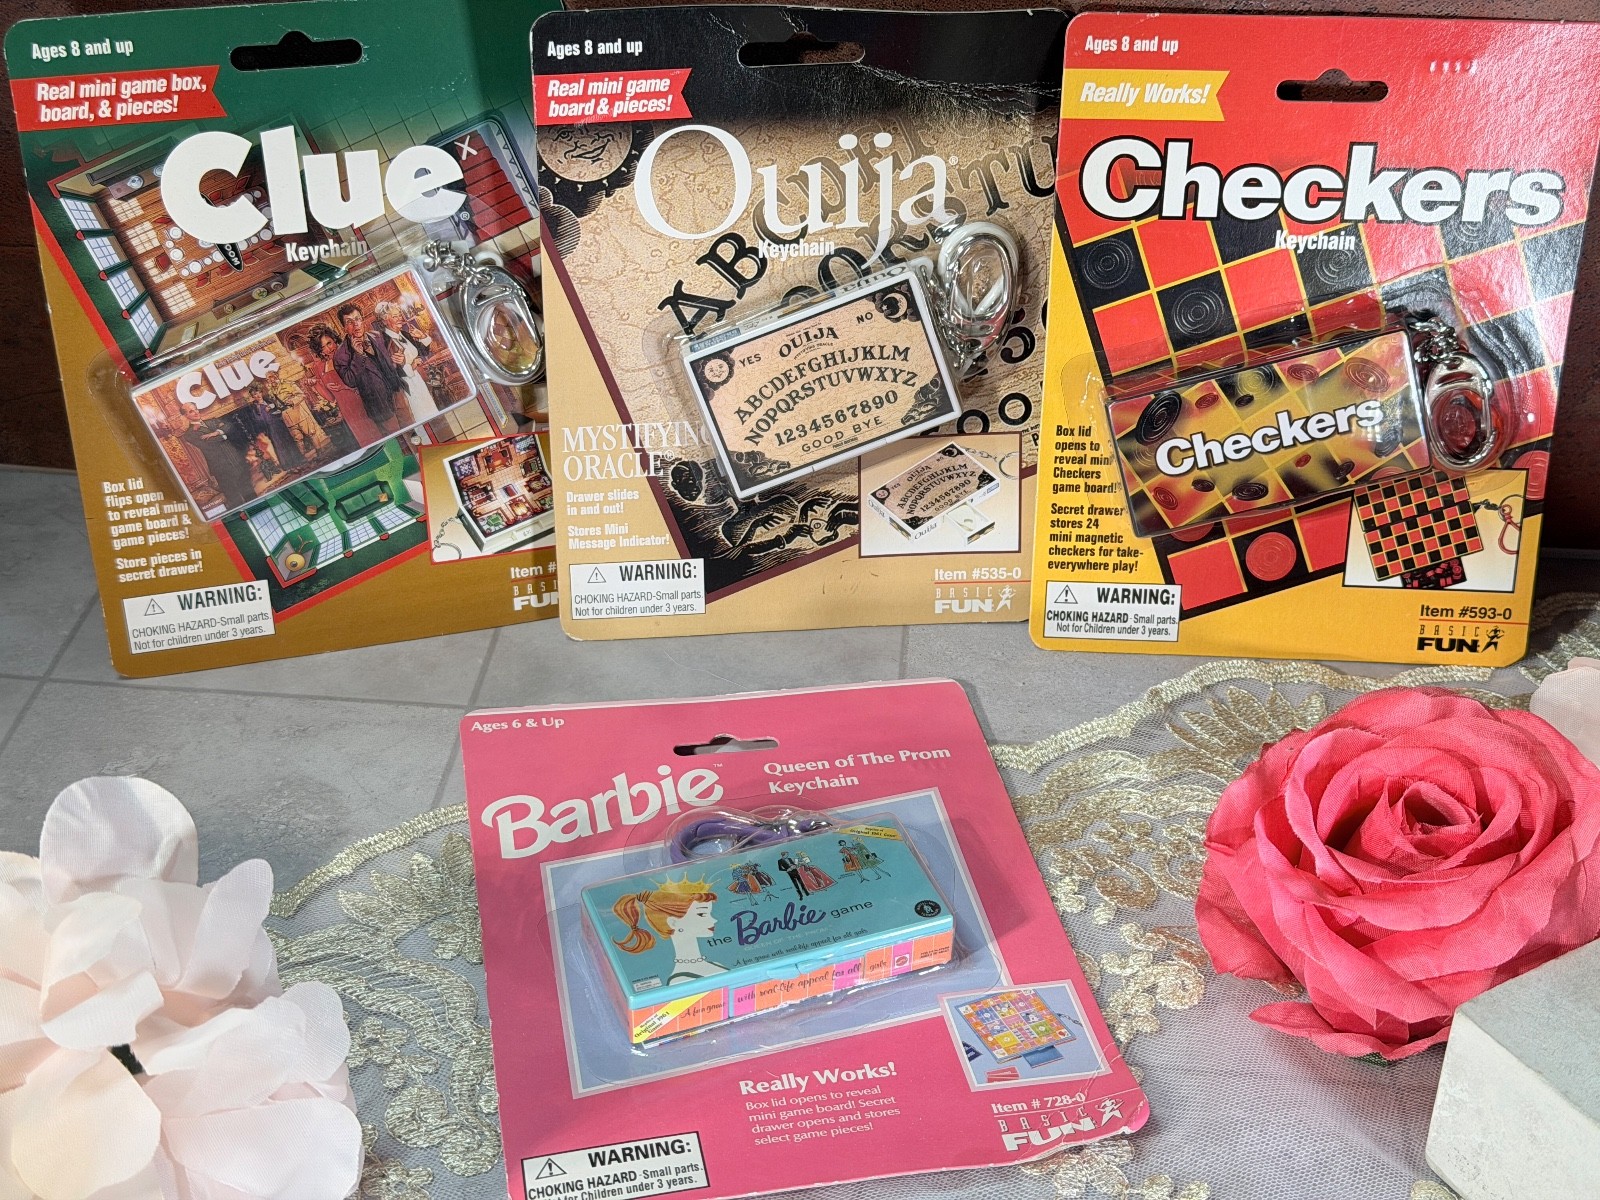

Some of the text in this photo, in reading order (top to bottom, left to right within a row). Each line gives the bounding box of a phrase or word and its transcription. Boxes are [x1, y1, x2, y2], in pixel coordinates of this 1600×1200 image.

[32, 38, 134, 62] Ages 8 and up
[547, 38, 643, 59] Ages 8 and up
[1084, 35, 1179, 55] Ages 8 and up
[37, 74, 207, 101] Real mini game box,
[547, 76, 671, 97] Real mini game
[1081, 82, 1212, 107] Really Works!
[40, 96, 178, 122] board, & pieces!
[548, 95, 673, 118] board & pieces!
[160, 125, 467, 244] Clue
[1079, 135, 1565, 226] Checkers
[634, 124, 957, 269] Ouija
[286, 239, 368, 262] Keychain
[759, 239, 835, 259] Keychain
[1274, 229, 1356, 253] Keychain
[856, 312, 873, 324] NO
[779, 326, 840, 358] OUIJA
[739, 353, 762, 367] YES
[174, 349, 279, 410] Clue
[775, 390, 898, 446] 1234567890
[802, 431, 844, 452] GOOD
[852, 415, 882, 434] BYE
[1056, 425, 1092, 437] Box lid
[1154, 398, 1385, 477] Checkers
[1055, 441, 1100, 453] opens to
[1053, 467, 1102, 479] Checkers
[103, 478, 144, 494] Box lid
[567, 488, 639, 503] Drawer slides
[1052, 482, 1117, 494] game board!
[105, 491, 164, 509] flips open
[108, 509, 121, 521] to
[123, 504, 161, 519] reveal
[163, 500, 189, 514] mini
[567, 503, 624, 516] in and out!
[1050, 503, 1124, 516] Secret drawer
[110, 513, 192, 538] game board &
[568, 523, 629, 537] Stores Mini
[1050, 518, 1100, 530] stores 24
[112, 528, 190, 551] game pieces!
[568, 534, 670, 550] Message Indicator!
[1049, 532, 1124, 545] mini magnetic
[116, 549, 203, 571] Store pieces in
[1048, 545, 1144, 558] checkers for take-
[119, 561, 204, 583] secret drawer!
[619, 564, 697, 582] WARNING:
[934, 567, 1022, 580] Item #535-0
[1048, 560, 1138, 573] everywhere play!
[176, 584, 263, 611] WARNING:
[574, 593, 614, 605] CHOKING
[681, 590, 703, 602] parts.
[934, 598, 993, 614] FUN
[1097, 586, 1175, 605] WARNING:
[575, 603, 697, 617] Not for children under 3 years.
[1420, 604, 1512, 620] Item #593-0
[1056, 622, 1171, 637] Not for Children under 3 years.
[1417, 637, 1480, 653] FUN
[471, 717, 565, 733] Ages 6 & Up
[763, 748, 951, 776] Queen of The Prom
[768, 774, 859, 796] Keychain
[481, 765, 724, 859] Barbie
[706, 934, 732, 948] the
[730, 901, 826, 946] Barbie
[830, 900, 873, 919] game
[739, 1061, 897, 1095] Really Works!
[745, 1085, 881, 1111] Box lid opens to reveal
[991, 1092, 1086, 1114] Item # 728-0
[748, 1096, 897, 1122] mini game board! Secret
[751, 1108, 901, 1134] drawer opens and stores
[754, 1122, 874, 1146] select game pieces!
[1002, 1116, 1096, 1152] FUN
[588, 1139, 692, 1168] WARNING:
